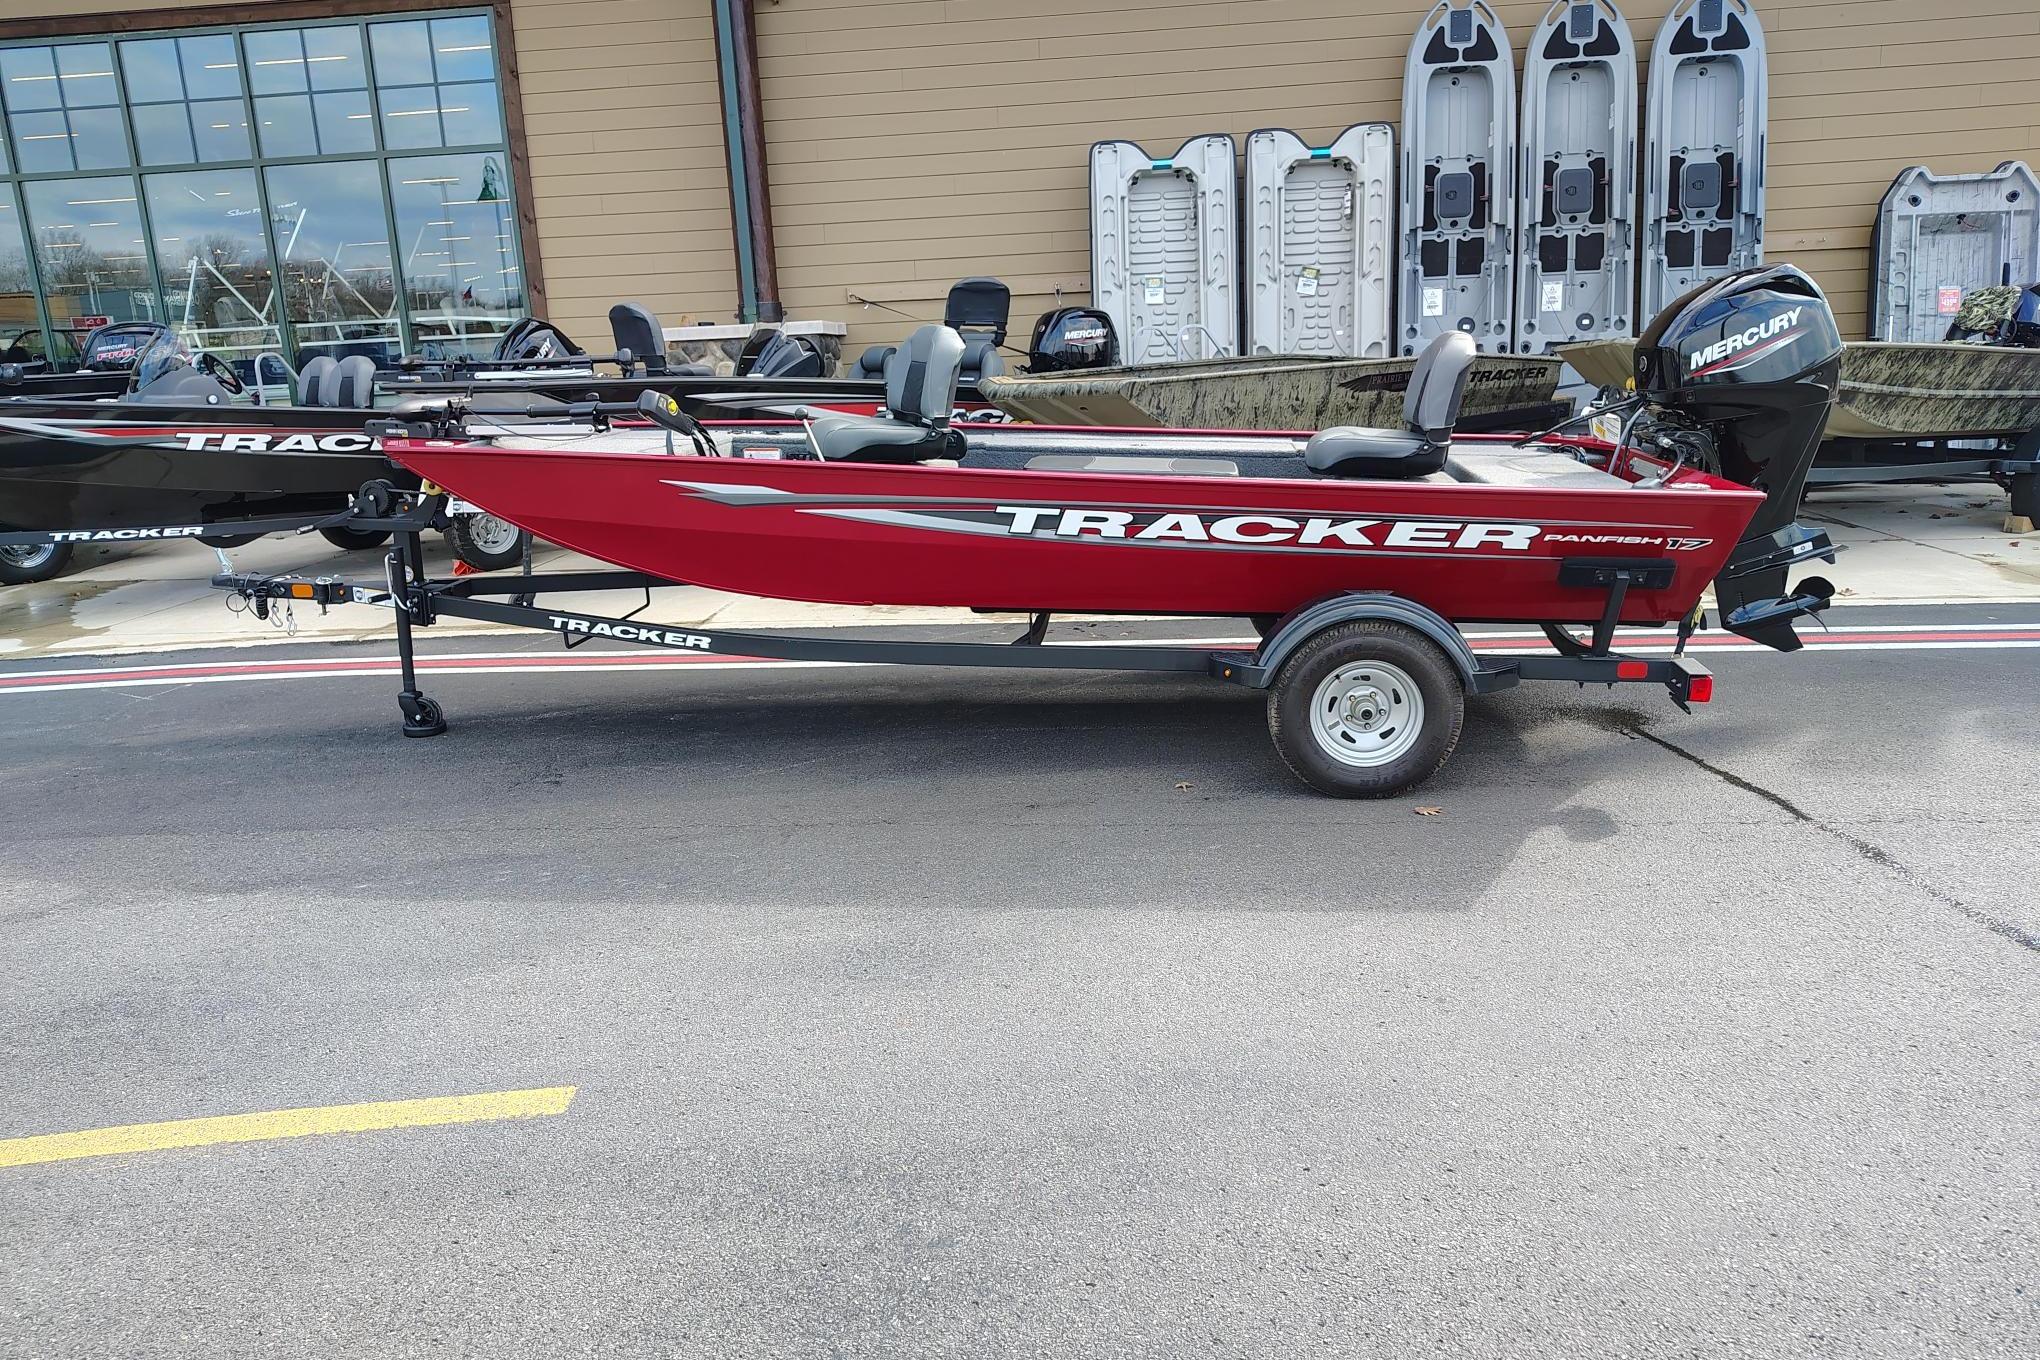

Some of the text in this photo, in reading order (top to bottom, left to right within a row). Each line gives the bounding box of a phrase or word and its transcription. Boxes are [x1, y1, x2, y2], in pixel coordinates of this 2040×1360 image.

[1064, 328, 1108, 340] MERCURY
[1690, 305, 1803, 370] MERCURY
[1371, 374, 1403, 385] PRAIRIE
[1470, 367, 1548, 382] TRACKER
[176, 432, 384, 452] TRAC
[49, 526, 204, 542] TRACKER
[995, 506, 1714, 551] TRACKER PANFISH 17
[549, 616, 712, 649] TRACKER
